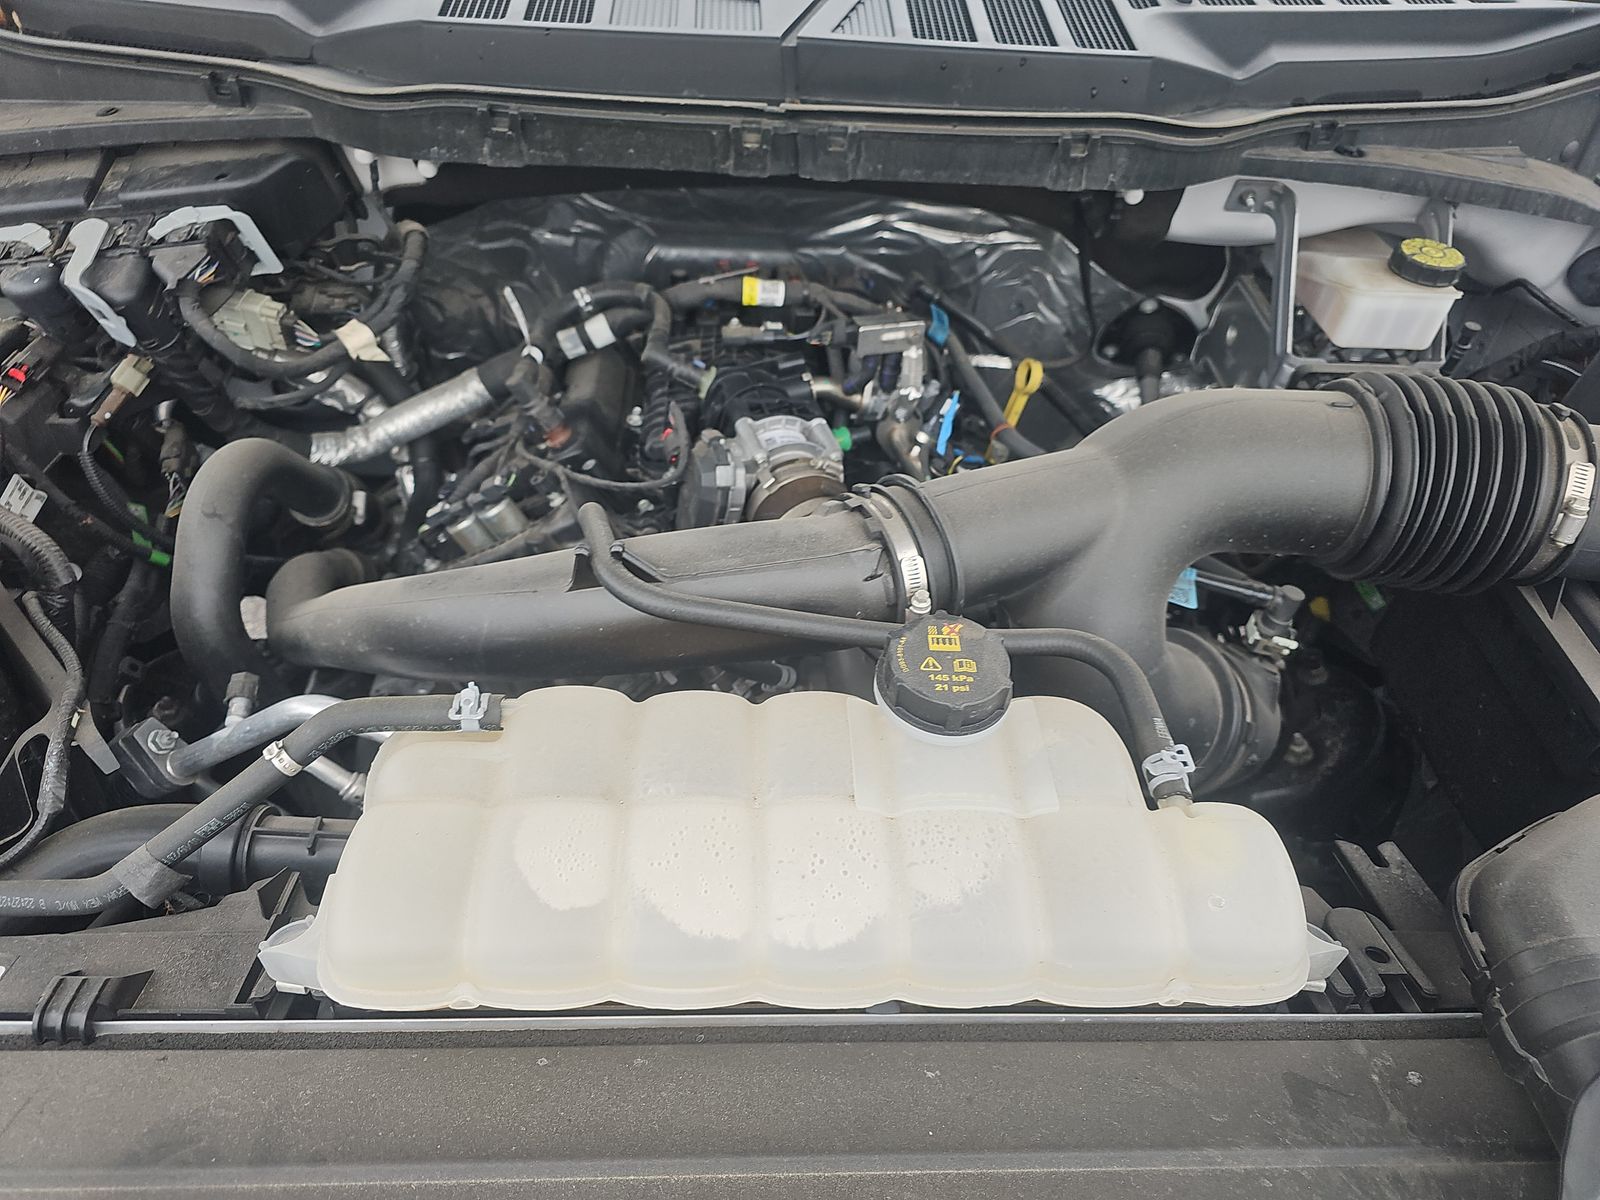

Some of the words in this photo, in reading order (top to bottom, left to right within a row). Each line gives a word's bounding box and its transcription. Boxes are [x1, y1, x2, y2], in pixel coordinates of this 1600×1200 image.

[952, 674, 974, 682] kPa
[935, 683, 948, 691] 21
[952, 684, 970, 692] psi
